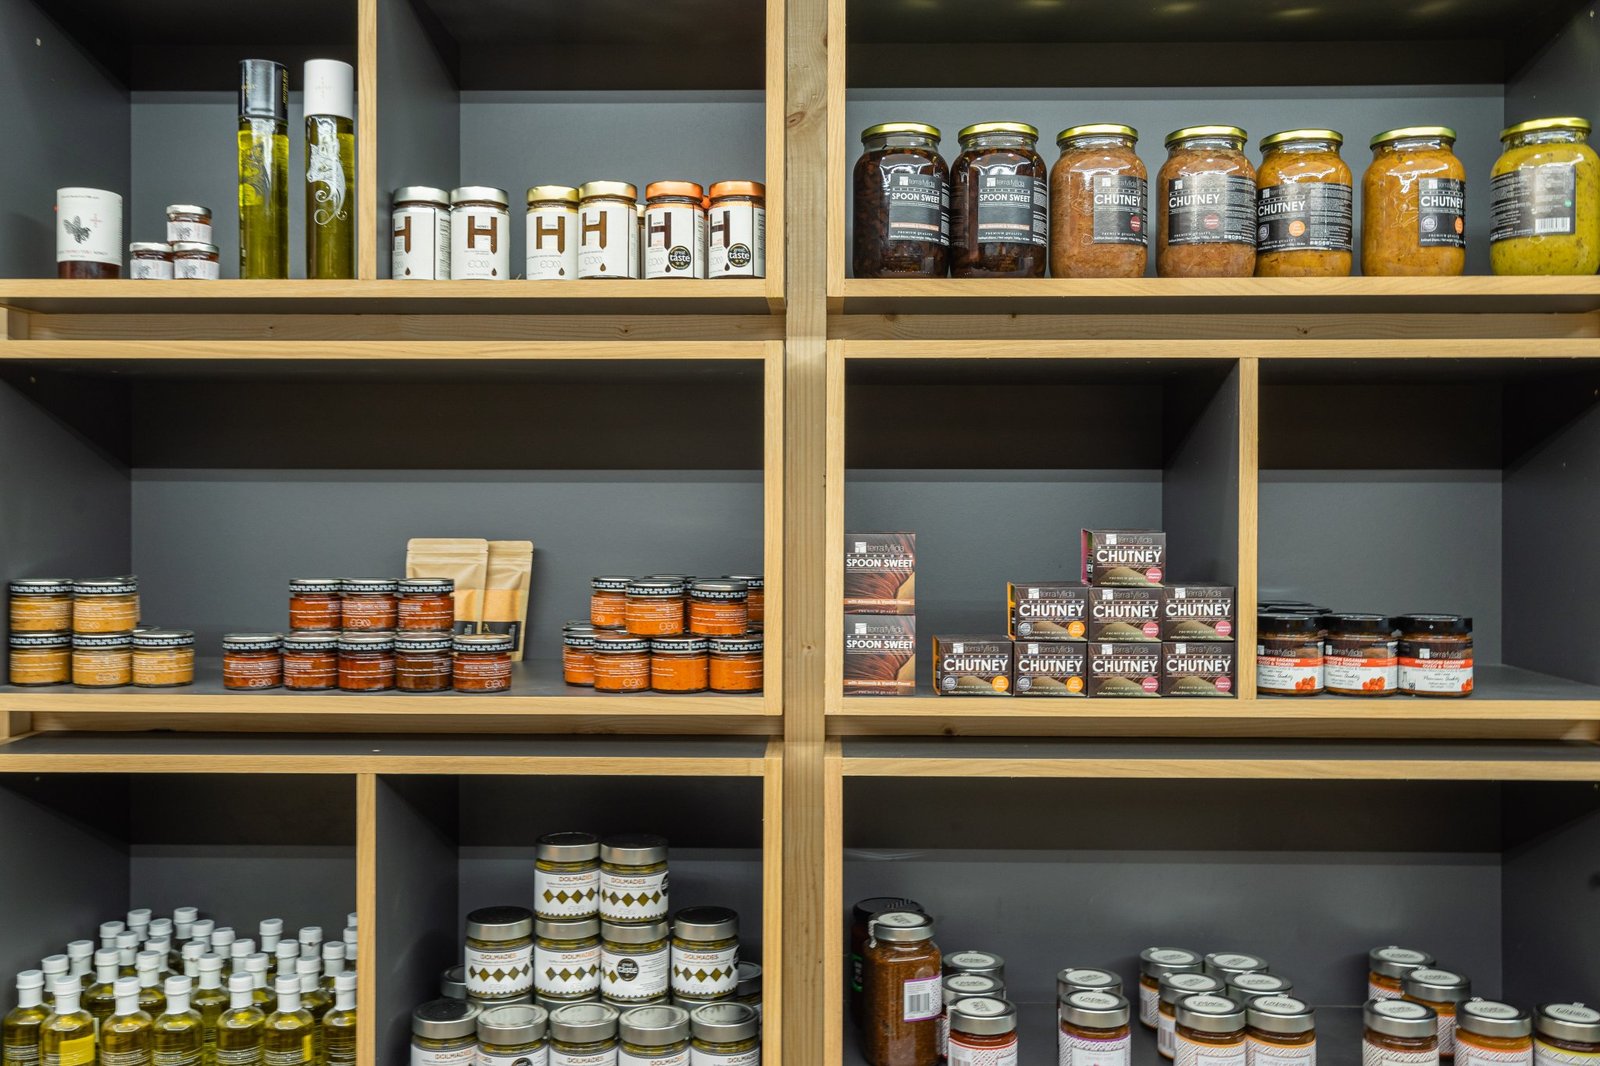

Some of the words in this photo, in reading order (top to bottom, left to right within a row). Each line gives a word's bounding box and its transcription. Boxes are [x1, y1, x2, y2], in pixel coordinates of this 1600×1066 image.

[891, 192, 920, 201] SPOON
[921, 194, 940, 204] SWEET
[979, 193, 1008, 202] SPOON
[1008, 194, 1031, 203] SWEET
[1094, 193, 1141, 207] CHUTNEY
[1169, 193, 1220, 208] CHUTNEY
[1421, 195, 1464, 209] CHUTNEY
[1257, 200, 1305, 217] CHUTNEY
[467, 215, 497, 254] H
[536, 215, 565, 254] H
[581, 210, 607, 250] H
[648, 212, 671, 251] H
[670, 254, 691, 263] taste
[729, 252, 750, 260] taste
[846, 558, 881, 567] SPOON
[884, 559, 913, 568] SWEET
[1096, 550, 1162, 563] CHUTNEY
[1018, 604, 1085, 617] CHUTNEY
[1092, 605, 1159, 618] CHUTNEY
[1165, 603, 1231, 616] CHUTNEY
[846, 639, 881, 648] SPOON
[884, 639, 913, 649] SWEET
[943, 659, 1008, 671] CHUTNEY
[1018, 659, 1083, 672] CHUTNEY
[1092, 659, 1158, 673] CHUTNEY
[1165, 659, 1231, 672] CHUTNEY
[558, 873, 593, 882] DOLMADES
[610, 877, 646, 885] DOLMADES
